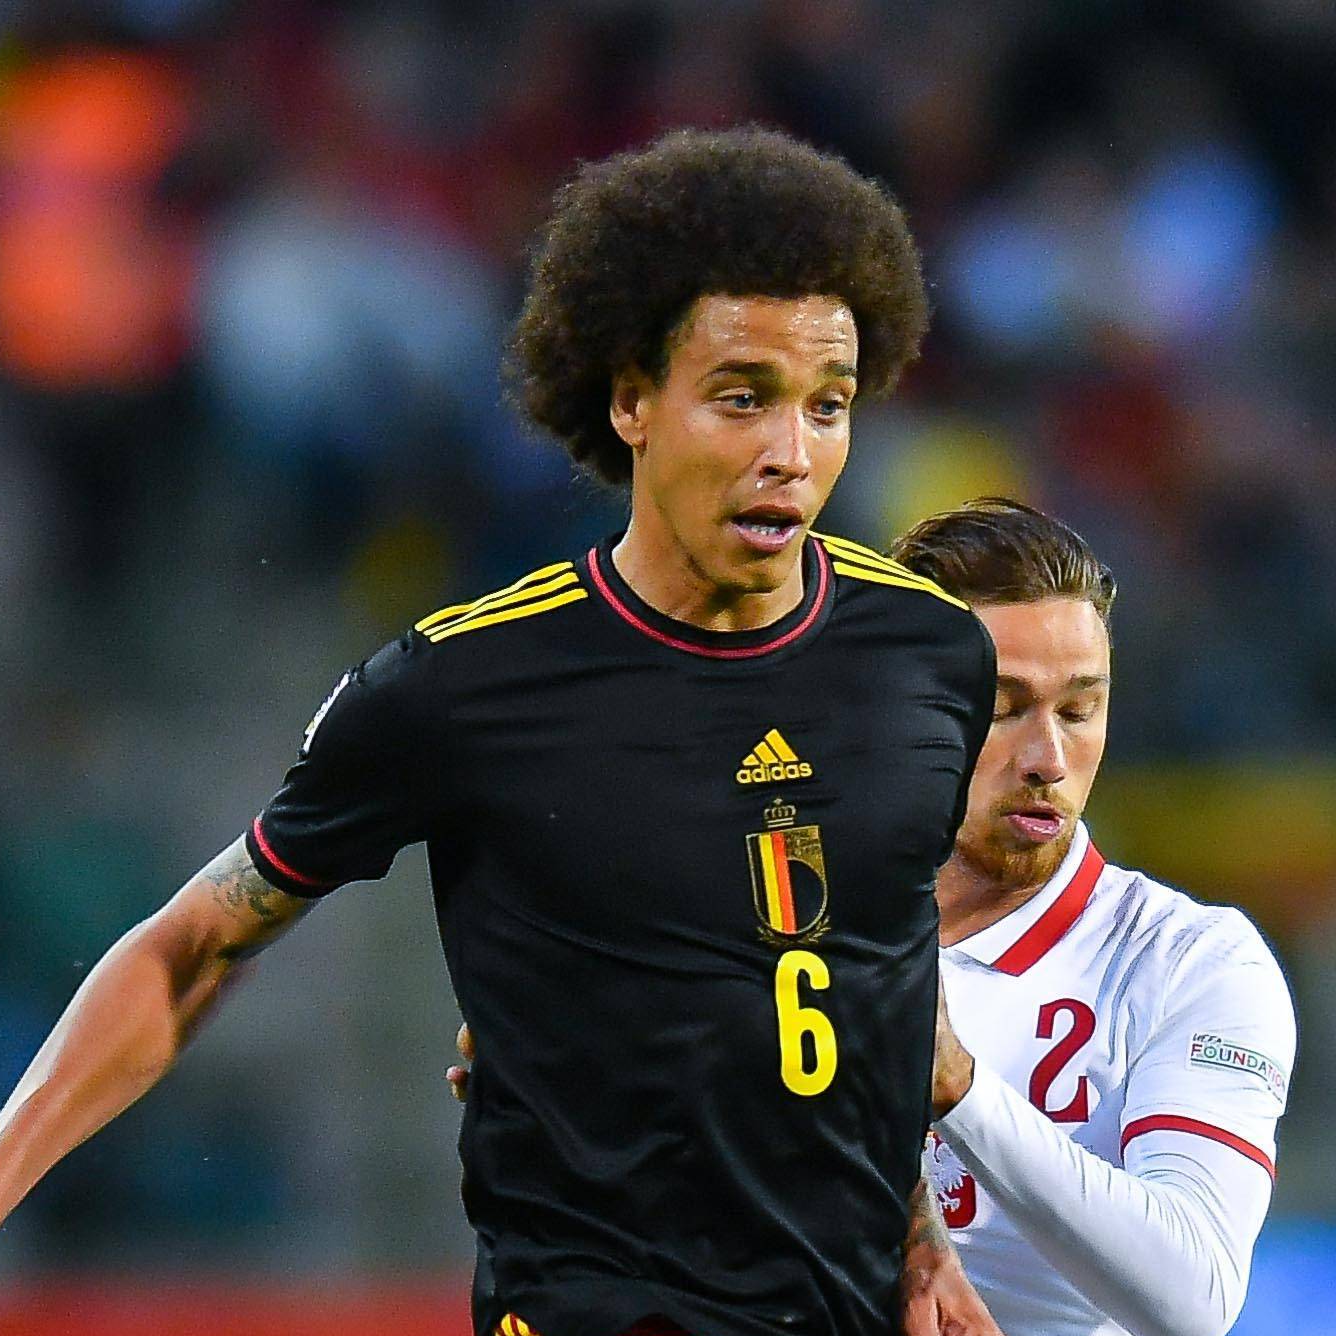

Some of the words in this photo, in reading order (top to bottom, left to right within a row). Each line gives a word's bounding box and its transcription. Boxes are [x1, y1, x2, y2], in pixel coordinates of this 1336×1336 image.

[736, 760, 813, 784] adidas
[775, 950, 838, 1096] 6
[1029, 998, 1096, 1123] 2
